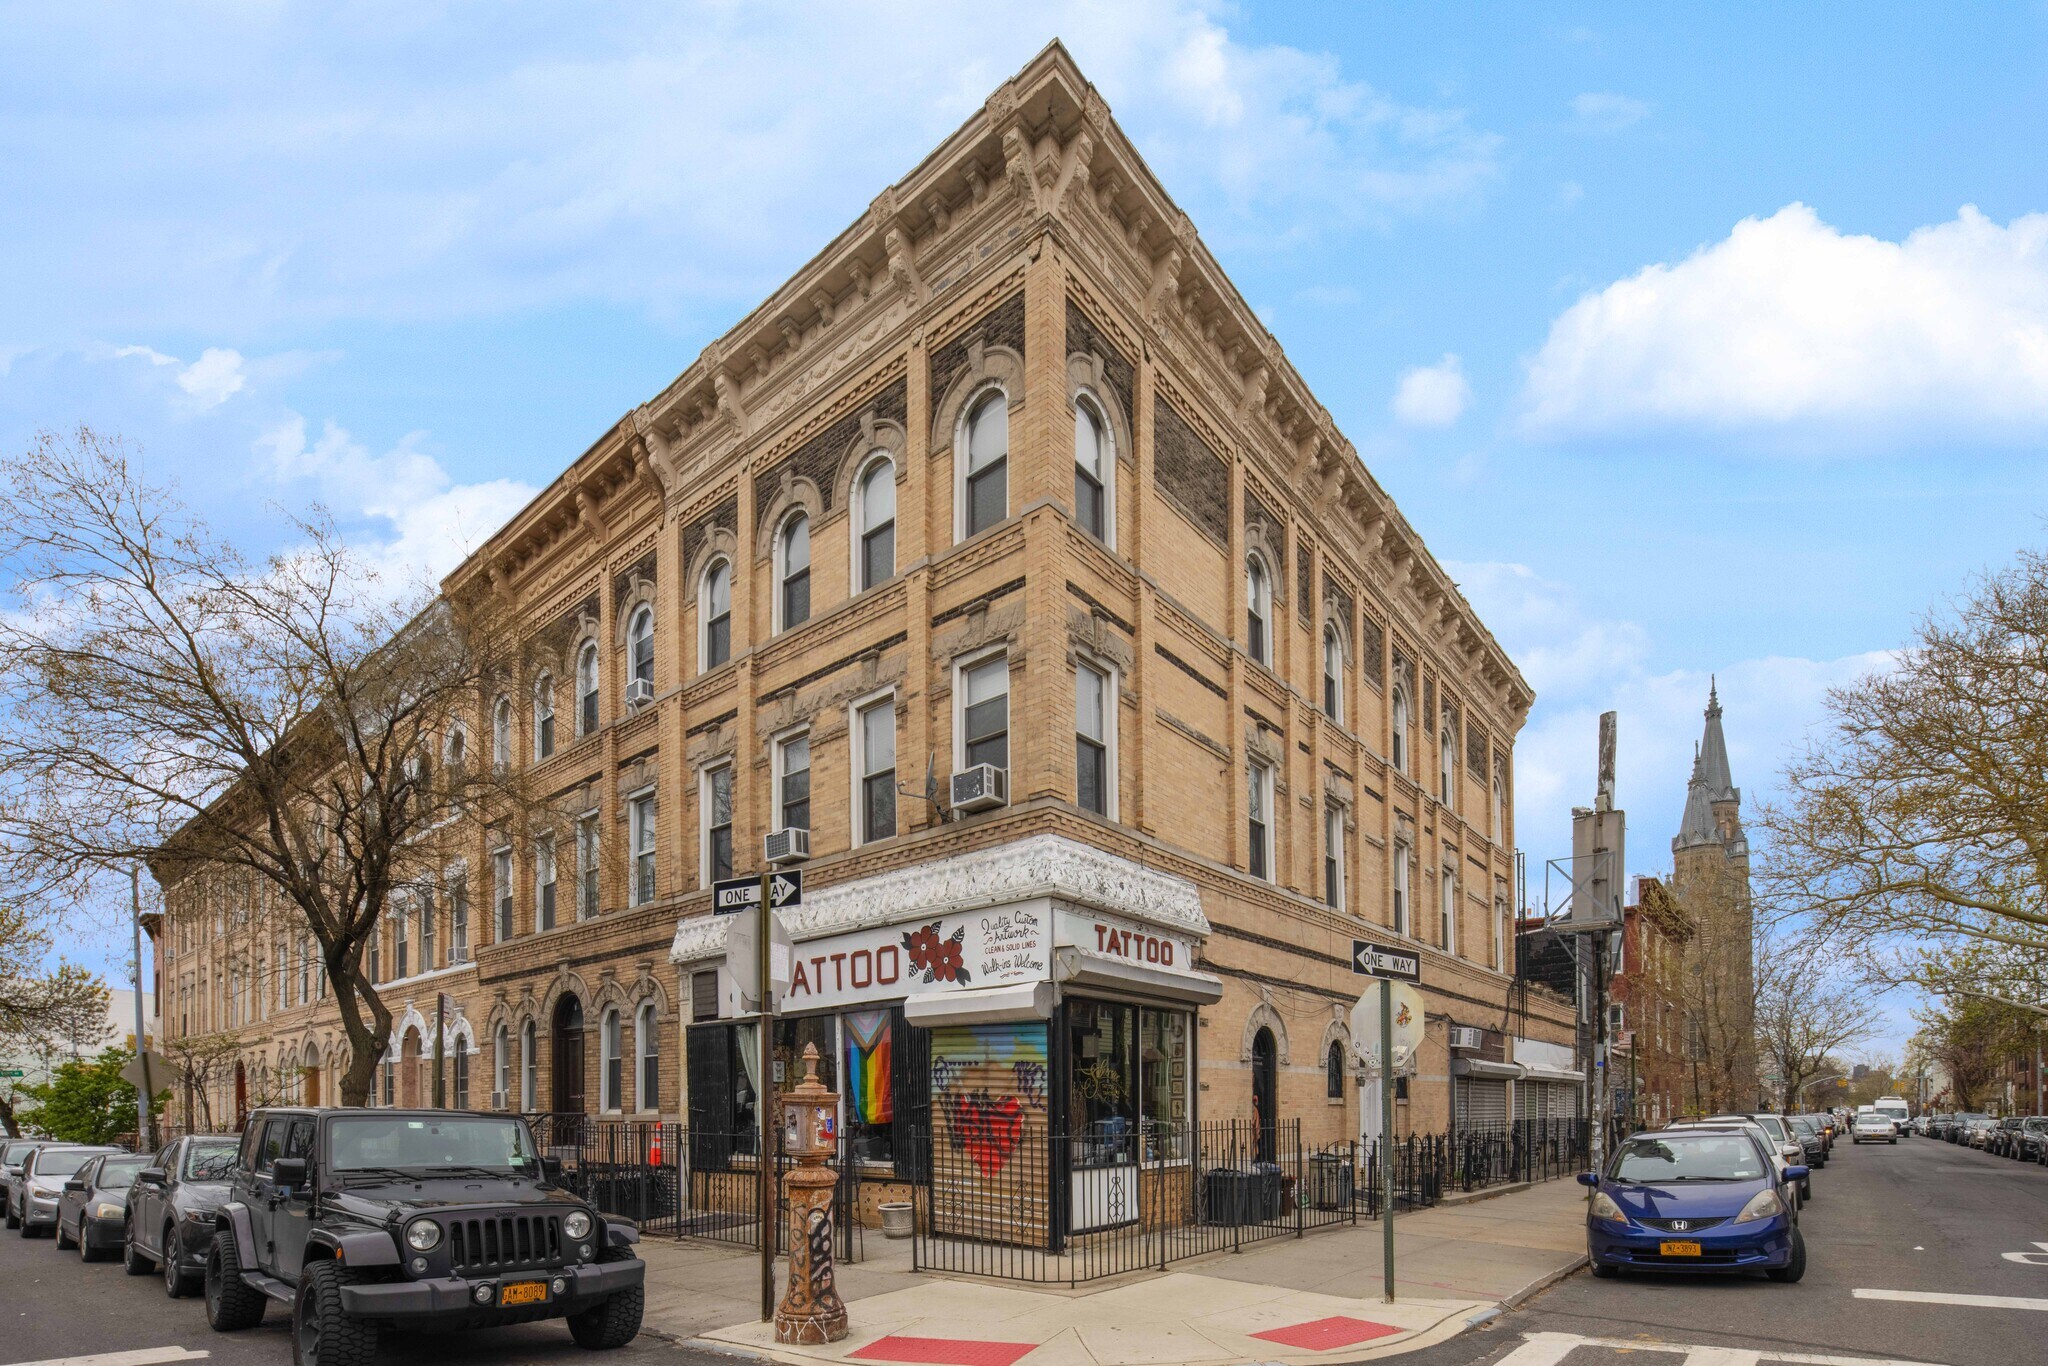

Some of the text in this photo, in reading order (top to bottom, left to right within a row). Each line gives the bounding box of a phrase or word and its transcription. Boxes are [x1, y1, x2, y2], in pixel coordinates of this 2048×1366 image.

[725, 883, 788, 904] ONE AY
[981, 910, 1038, 936] Quality Custom
[993, 925, 1029, 944] Artwork
[1095, 924, 1173, 966] TATTOO
[984, 945, 1001, 955] CLEAN
[1005, 943, 1020, 952] SOLID
[1021, 940, 1037, 949] LINES
[790, 945, 899, 997] ATTOO
[981, 953, 1044, 977] Walk-ins Welcome
[1363, 952, 1412, 972] ONE WAY
